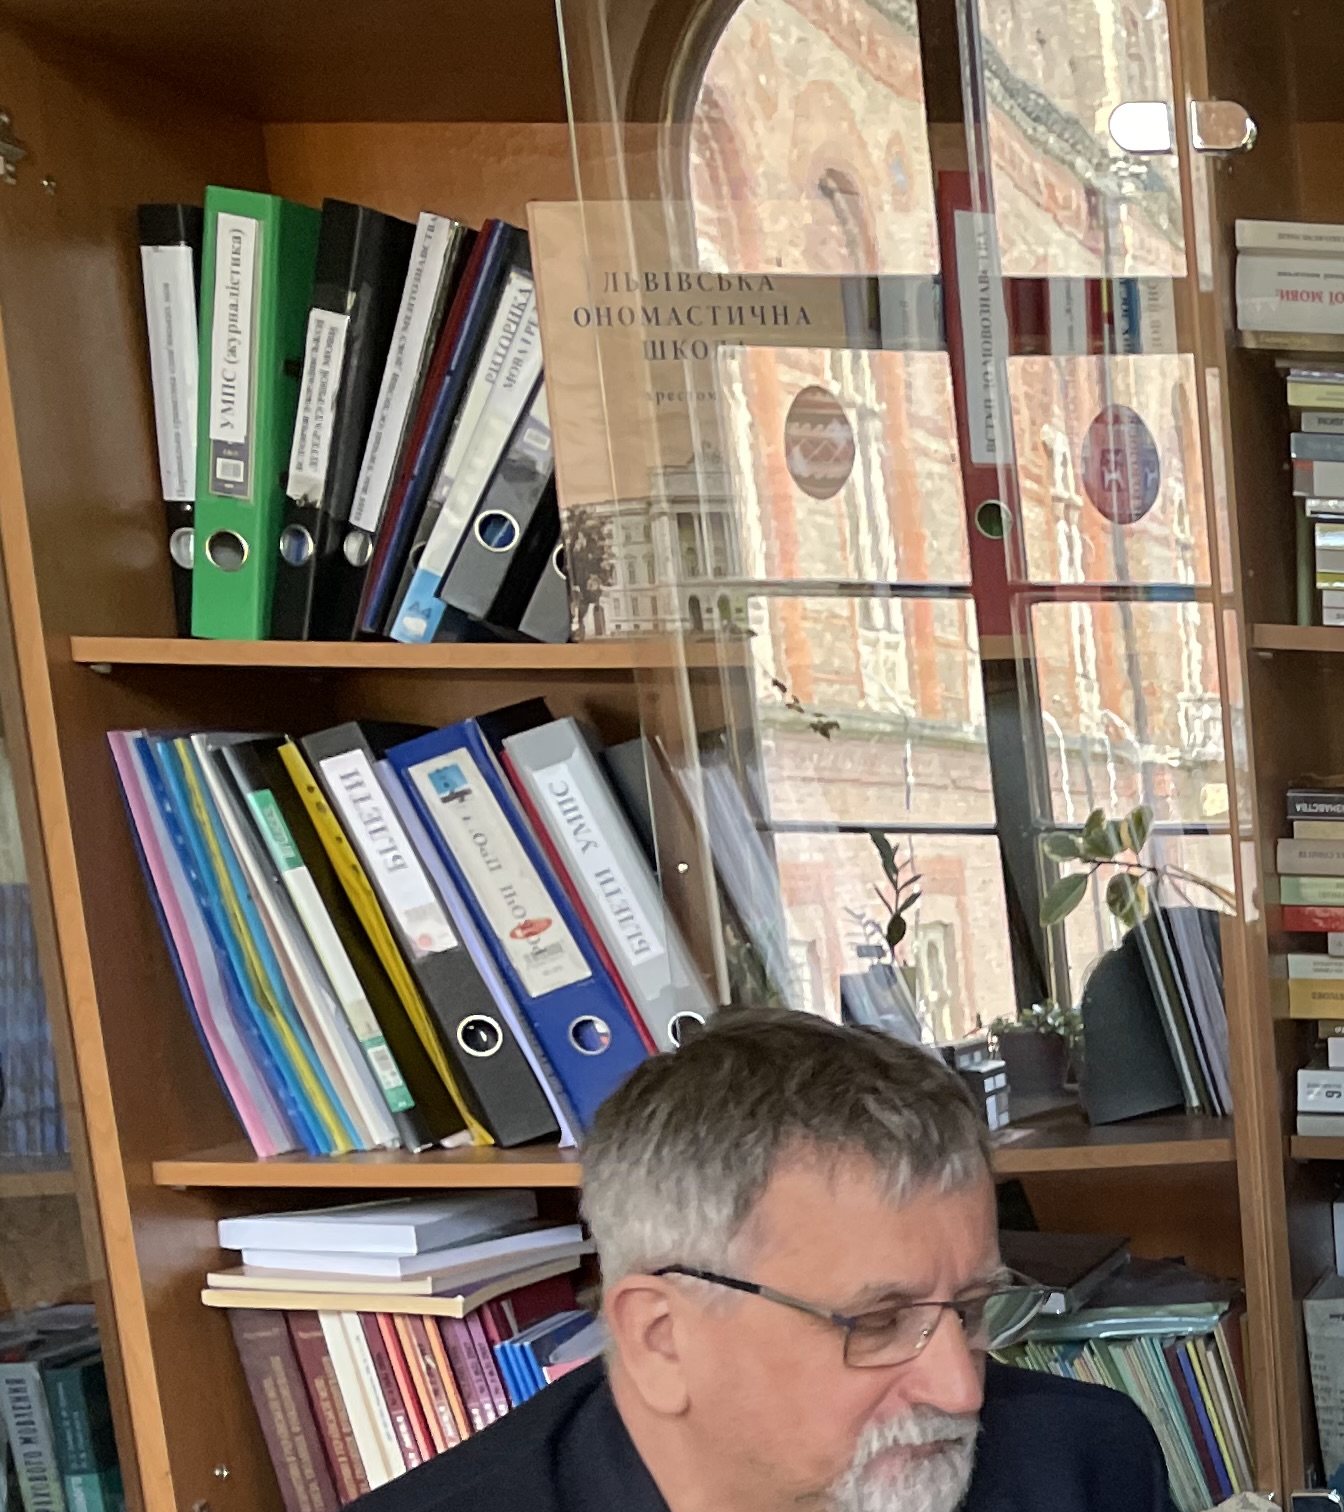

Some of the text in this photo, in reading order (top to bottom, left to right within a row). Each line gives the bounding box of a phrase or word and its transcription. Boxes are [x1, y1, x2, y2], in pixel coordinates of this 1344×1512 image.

[572, 305, 812, 328] ОНОМАСТИЧНА
[602, 271, 776, 293] ЛЬВІВСЬКА
[218, 227, 250, 430] УМПС (журналістика)
[473, 282, 540, 385] РИТОРИКА
[497, 346, 531, 391] МОВА
[337, 765, 408, 877] БІЛЕТИ
[543, 774, 654, 958] БІЛЕТИ УМПС
[3, 1374, 40, 1447] МОВЛЕННЯ
